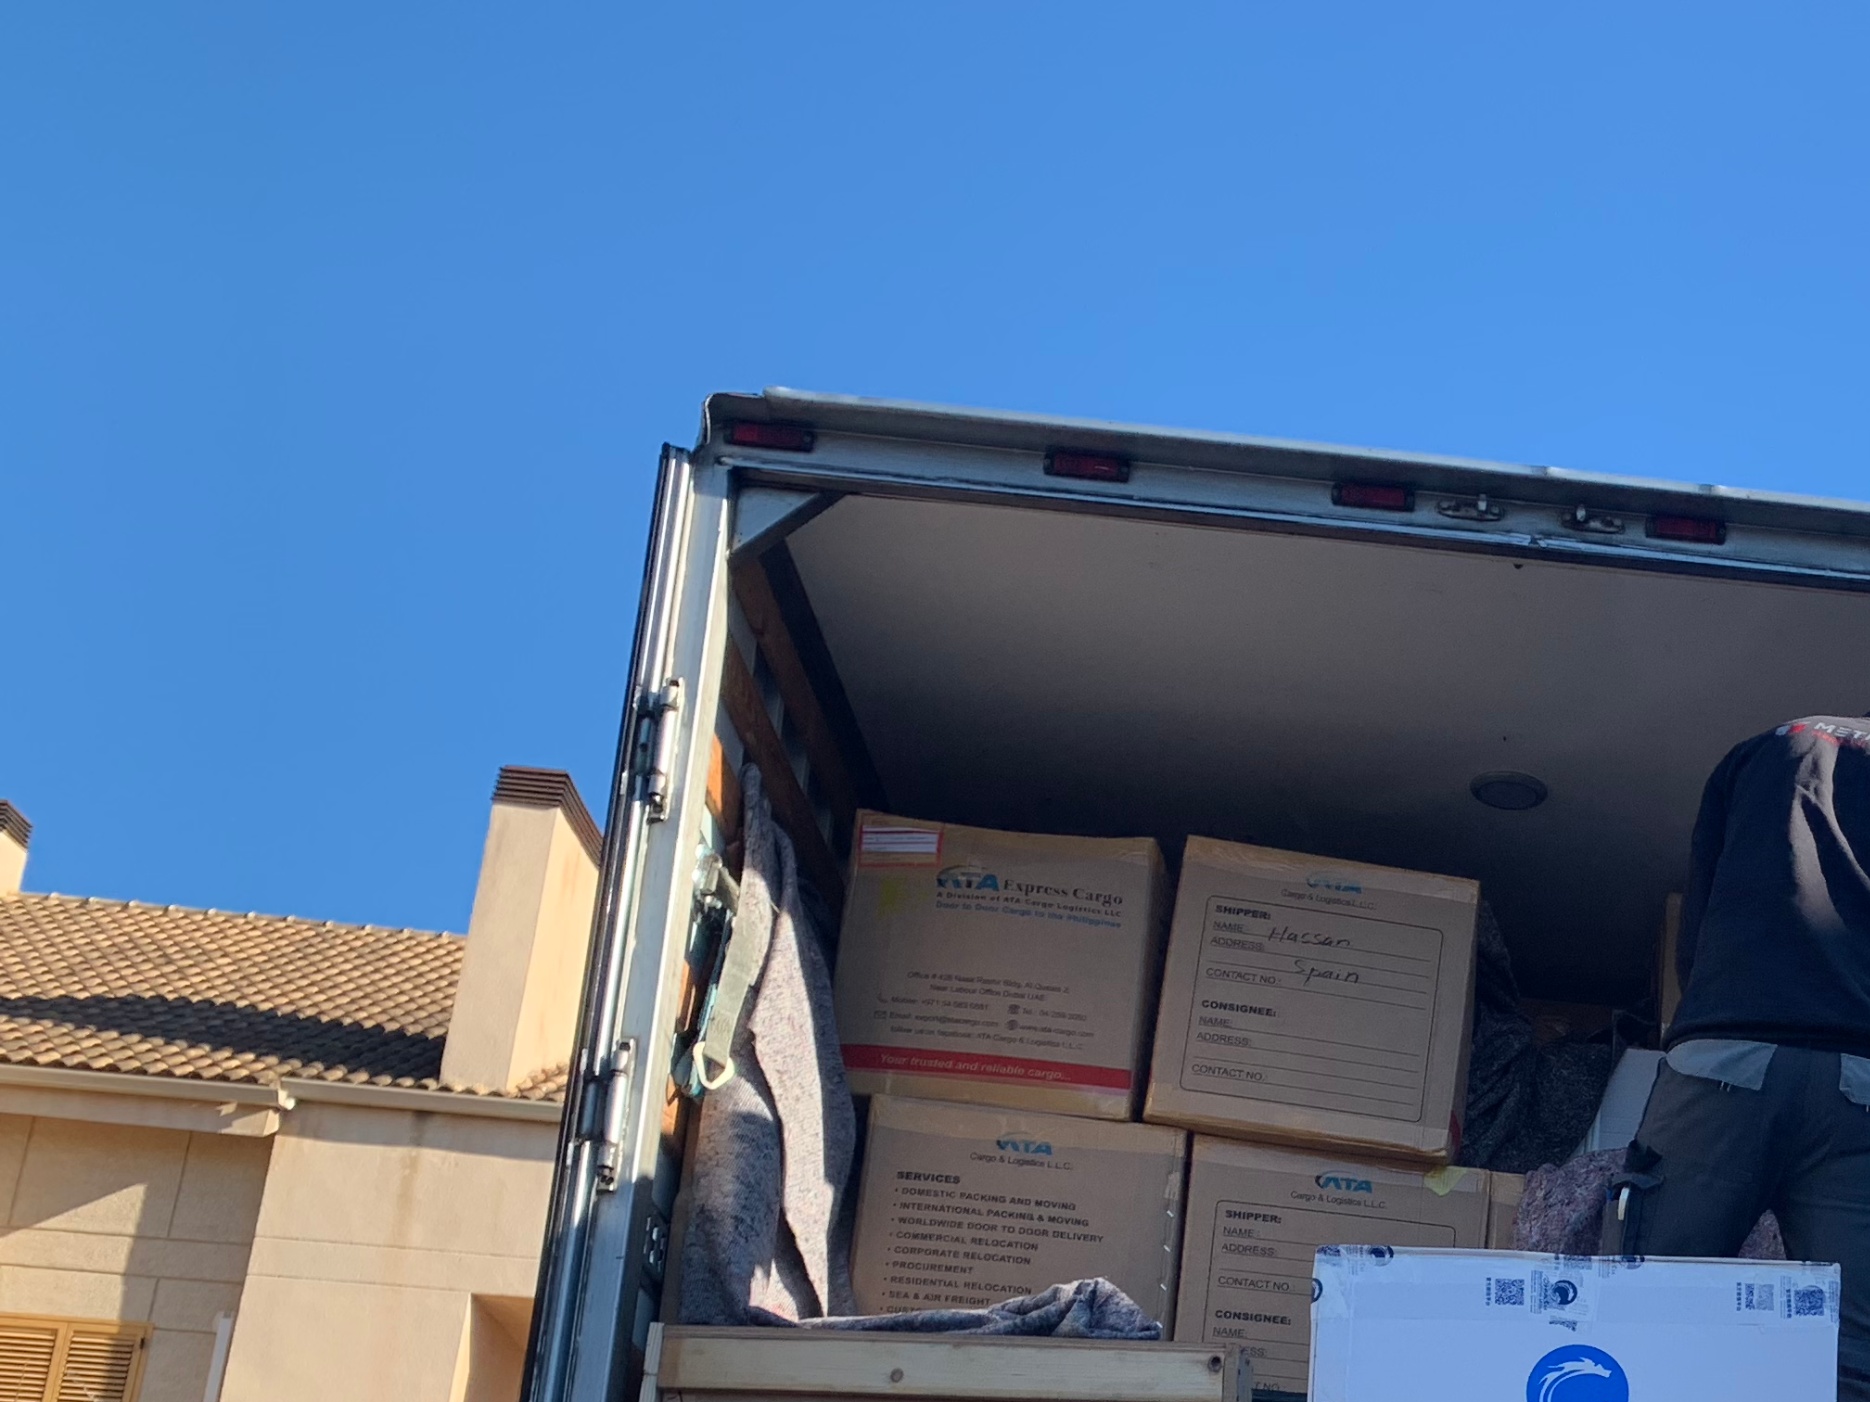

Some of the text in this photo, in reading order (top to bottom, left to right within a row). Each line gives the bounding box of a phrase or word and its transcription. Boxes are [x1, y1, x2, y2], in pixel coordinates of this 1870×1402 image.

[1003, 879, 1068, 898] Express
[1072, 887, 1123, 907] Cargo
[1024, 898, 1054, 909] Cargo
[1215, 904, 1272, 920] SHIPPER:
[1205, 967, 1257, 983] CONTACT
[1291, 959, 1360, 986] Spain
[1201, 1000, 1277, 1018] CONSIGNEE:
[1195, 1031, 1252, 1048] ADDRESS:
[879, 1053, 909, 1065] Your
[910, 1055, 954, 1070] trusted
[955, 1060, 979, 1071] and
[980, 1062, 1026, 1077] reliable
[1191, 1062, 1243, 1079] CONTACT
[970, 1151, 997, 1163] Cargo
[1007, 1156, 1046, 1168] Logistics
[897, 1171, 961, 1185] SERVICES
[901, 1187, 1077, 1211] DOMESTIC PACKING AND MOVING
[1290, 1189, 1316, 1203] Cargo
[899, 1202, 984, 1217] INTERNATIONAL
[986, 1209, 1034, 1222] PACKING
[1048, 1215, 1090, 1228] MOVING
[1225, 1209, 1282, 1224] SHIPPER:
[897, 1216, 1105, 1244] WORLDWIDE DOOR TO DOOR DELIVERY
[896, 1230, 1039, 1252] COMMERCIAL RELOCATION
[894, 1246, 1032, 1266] CORPORATE RELOCATION
[892, 1260, 974, 1275] PROCUREMENT
[890, 1275, 1033, 1296] RESIDENTIAL RELOCATION
[1217, 1275, 1271, 1290] CONTACT
[888, 1290, 911, 1300] SEA
[923, 1293, 942, 1302] AIR
[944, 1295, 992, 1307] FREIGHT
[1214, 1310, 1292, 1326] CONSIGNEE:
